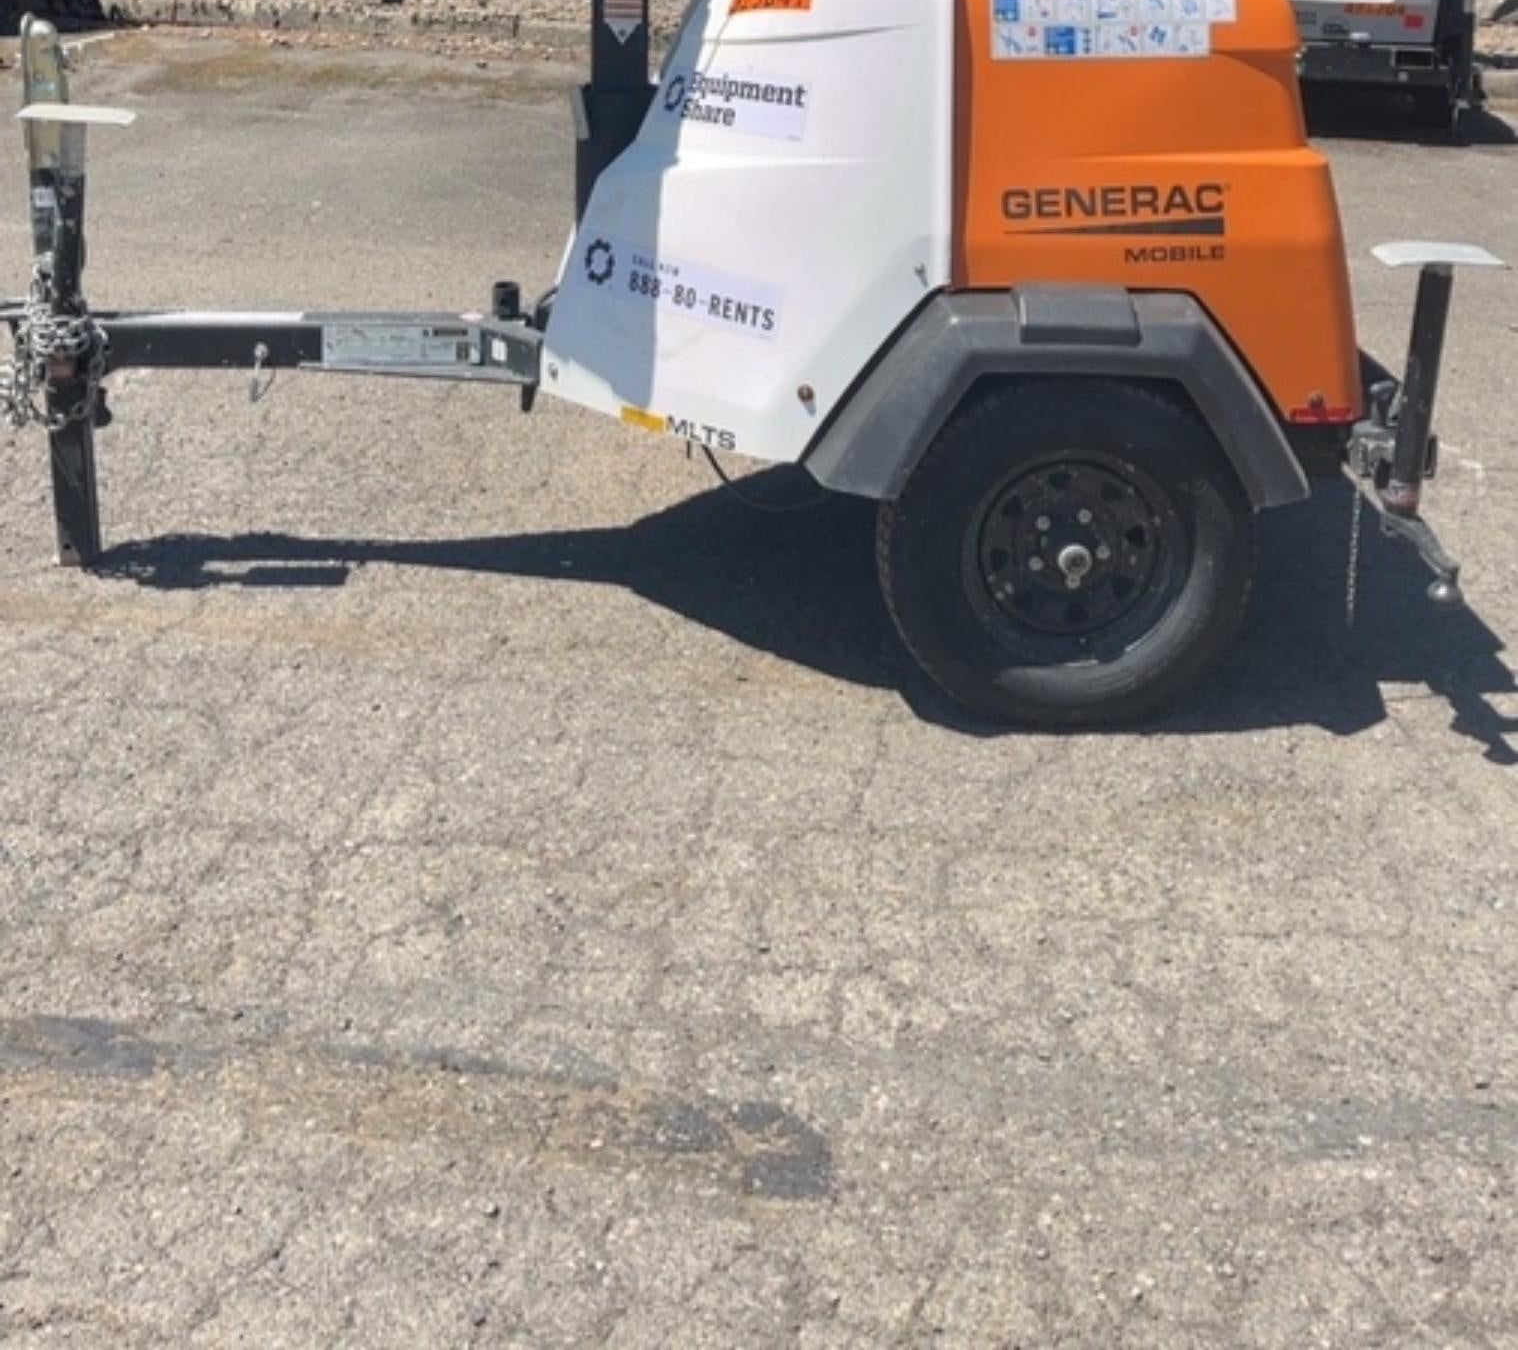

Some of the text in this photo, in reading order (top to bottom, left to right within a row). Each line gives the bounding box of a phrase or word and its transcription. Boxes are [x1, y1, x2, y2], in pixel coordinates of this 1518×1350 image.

[690, 71, 807, 108] Equipment
[681, 98, 736, 127] Share
[1002, 183, 1226, 220] GENERAC
[1124, 245, 1226, 264] MOBILE
[629, 269, 776, 332] 888-80-RENTS
[666, 414, 737, 451] MLTS
